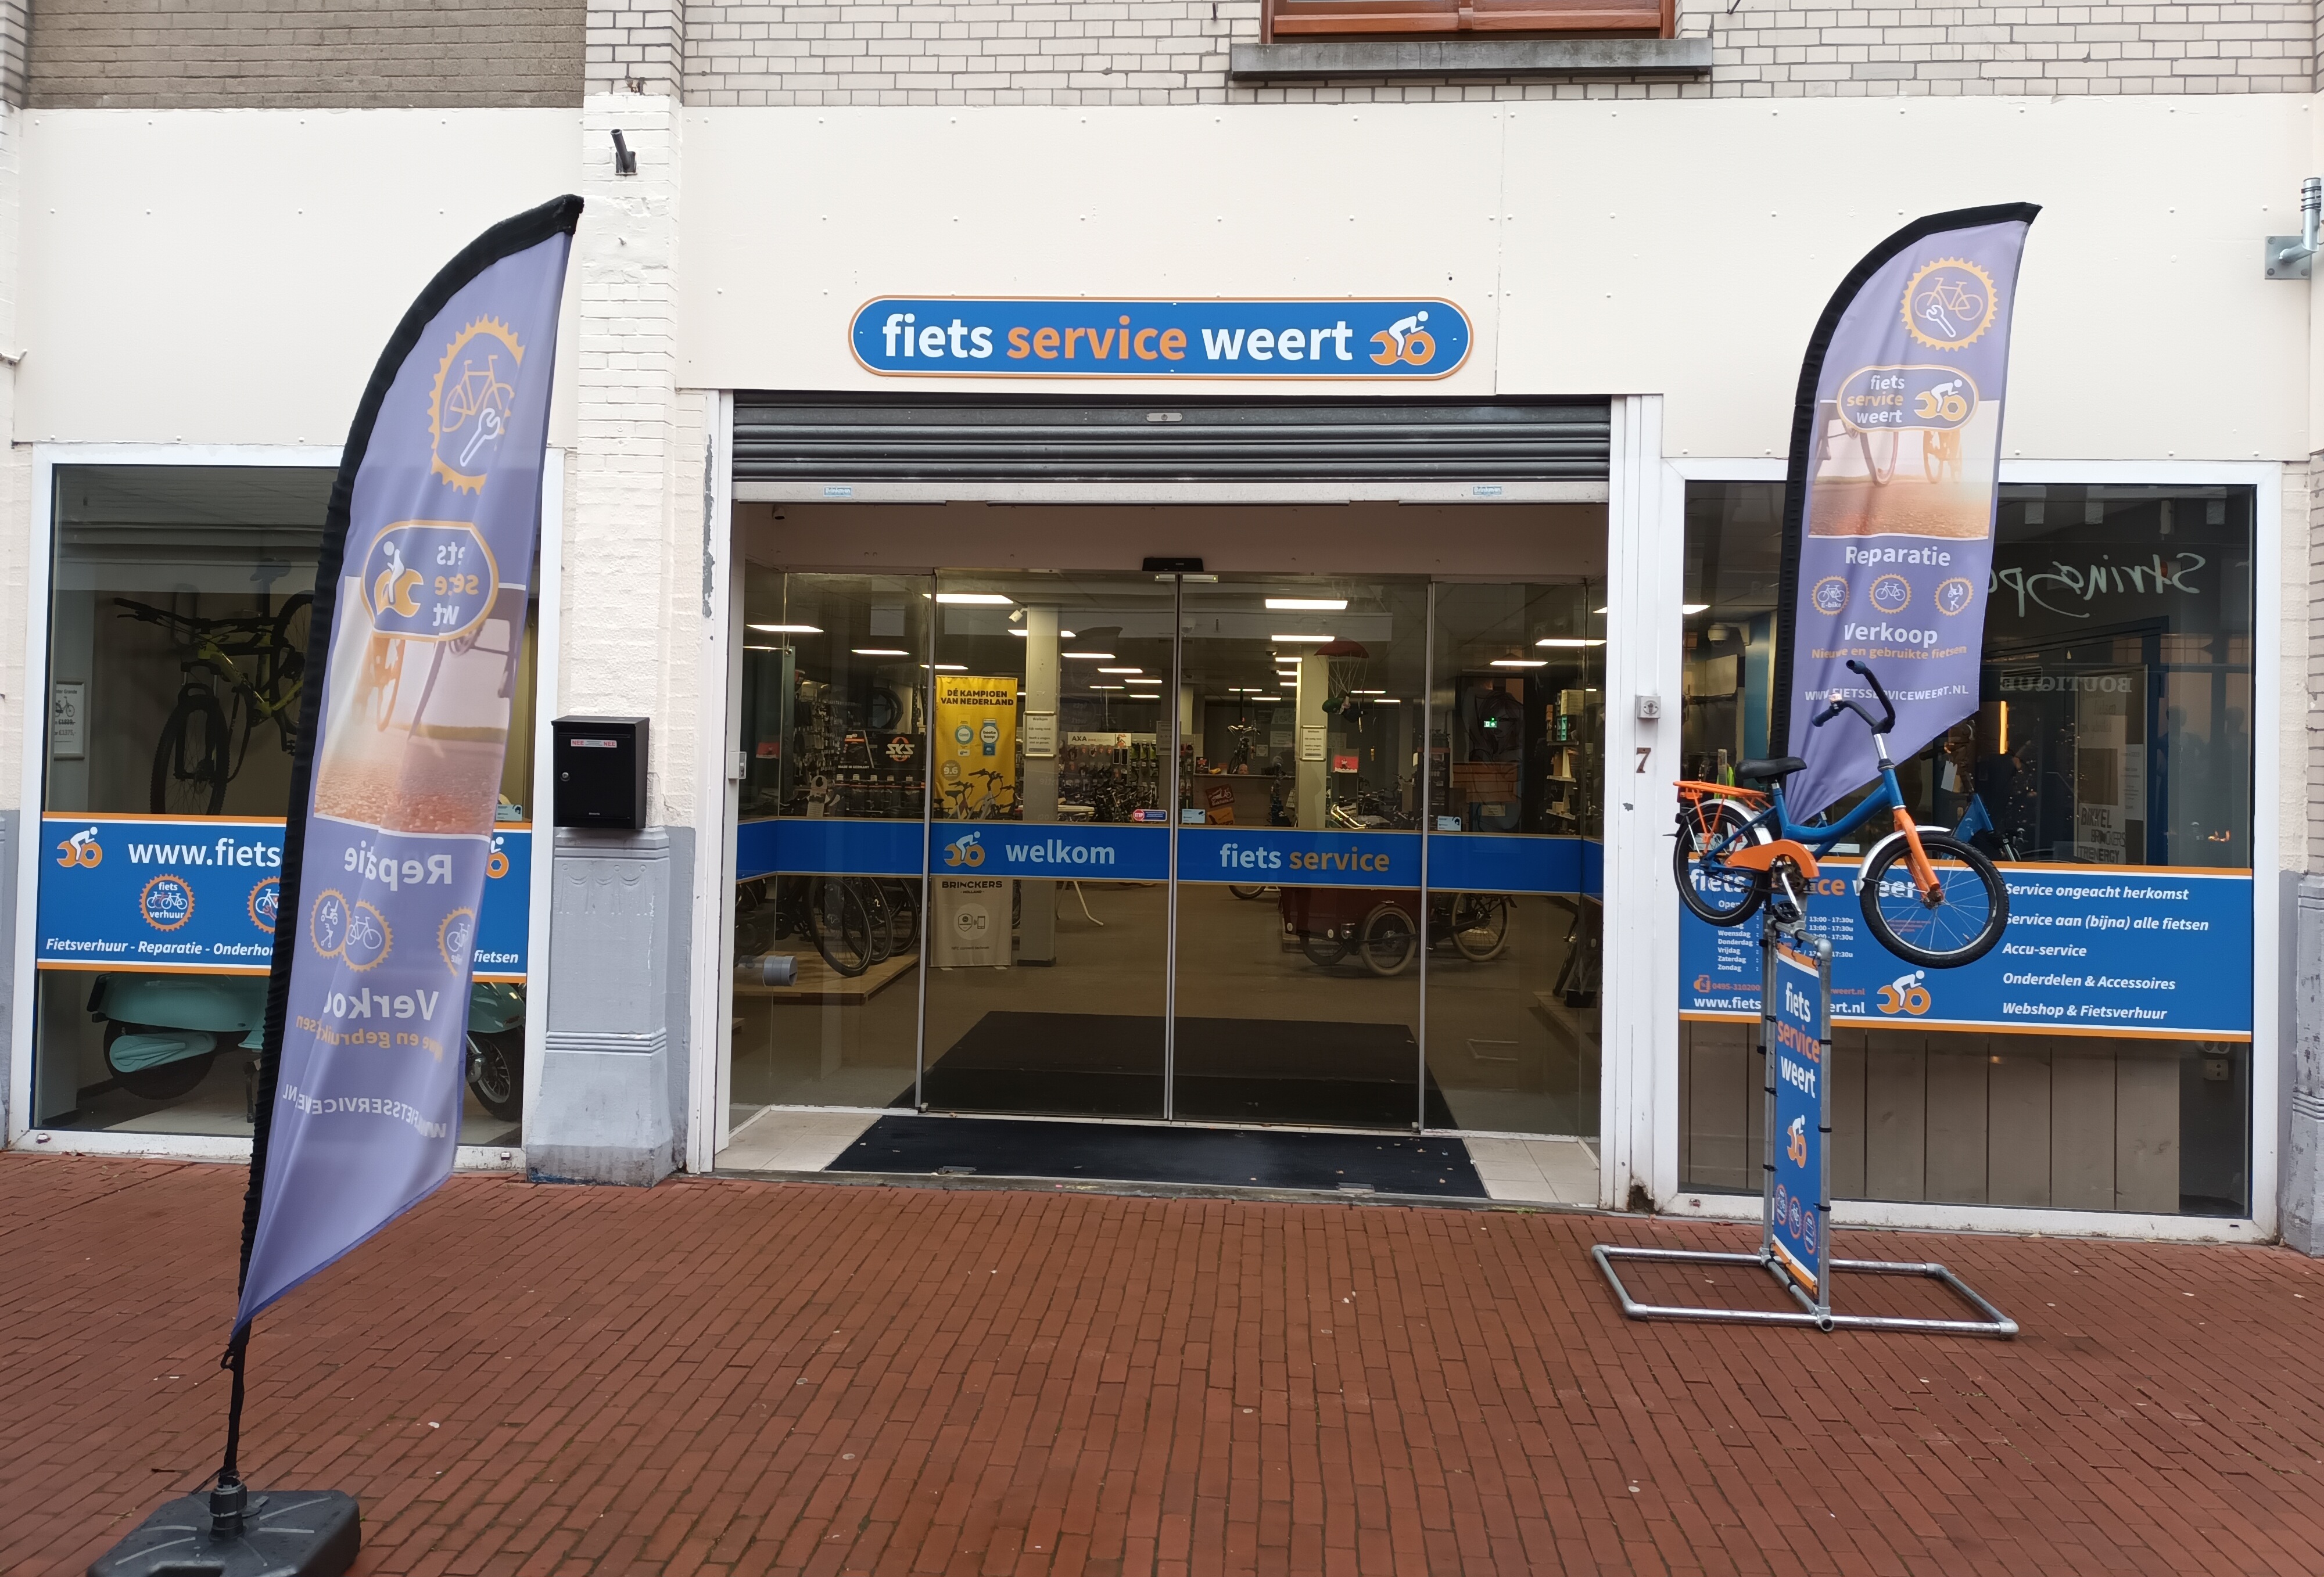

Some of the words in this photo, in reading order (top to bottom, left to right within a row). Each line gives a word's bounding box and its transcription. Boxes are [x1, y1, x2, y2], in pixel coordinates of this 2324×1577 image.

[883, 314, 992, 358] fiets
[1007, 315, 1187, 361] service
[1202, 320, 1353, 361] weert
[1870, 375, 1905, 390] fiets
[1846, 391, 1904, 407] service
[1856, 409, 1902, 423] weert
[1845, 546, 1951, 567] Reparatie
[1844, 623, 1938, 648] Verkoop
[1812, 646, 1848, 659] Nieuwe
[1851, 646, 1866, 656] en
[1869, 647, 1928, 659] gebruikte
[1931, 646, 1967, 659] fietsen
[947, 688, 958, 696] DÉ
[960, 698, 1014, 706] NEDERLAND
[885, 744, 914, 754] SKS
[1636, 748, 1651, 773] 7
[128, 838, 281, 868] www.fiets
[1006, 840, 1115, 864] welkom
[1220, 843, 1282, 869] fiets
[1289, 846, 1390, 872] service
[159, 882, 178, 891] fiets
[1691, 869, 1746, 893] fiets
[2006, 883, 2053, 896] Service
[2056, 885, 2120, 899] ongeacht
[2123, 886, 2189, 900] herkomst
[149, 910, 184, 919] verhuur
[2056, 917, 2081, 927] aan
[2085, 915, 2130, 931] (bijna)
[2133, 918, 2159, 929] alle
[2162, 918, 2209, 931] fietsen
[1717, 930, 1751, 938] Woensdag
[46, 939, 128, 952] Fietsverhuur
[138, 941, 202, 956] Reparatie
[213, 943, 273, 957] Onderho
[474, 950, 518, 964] fietsen
[1717, 939, 1753, 947] Donderdag
[2002, 943, 2087, 957] Accu-service
[2003, 972, 2081, 987] Onderdelen
[2085, 976, 2095, 987] &
[2097, 976, 2175, 990] Accessoires
[1694, 997, 1761, 1009] www.fiets
[1785, 982, 1810, 1022] fiets
[2003, 1002, 2064, 1018] Webshop
[2067, 1005, 2077, 1016] &
[2080, 1005, 2167, 1020] Fietsverhuur
[1777, 1021, 1821, 1063] service
[1781, 1056, 1816, 1098] weert
